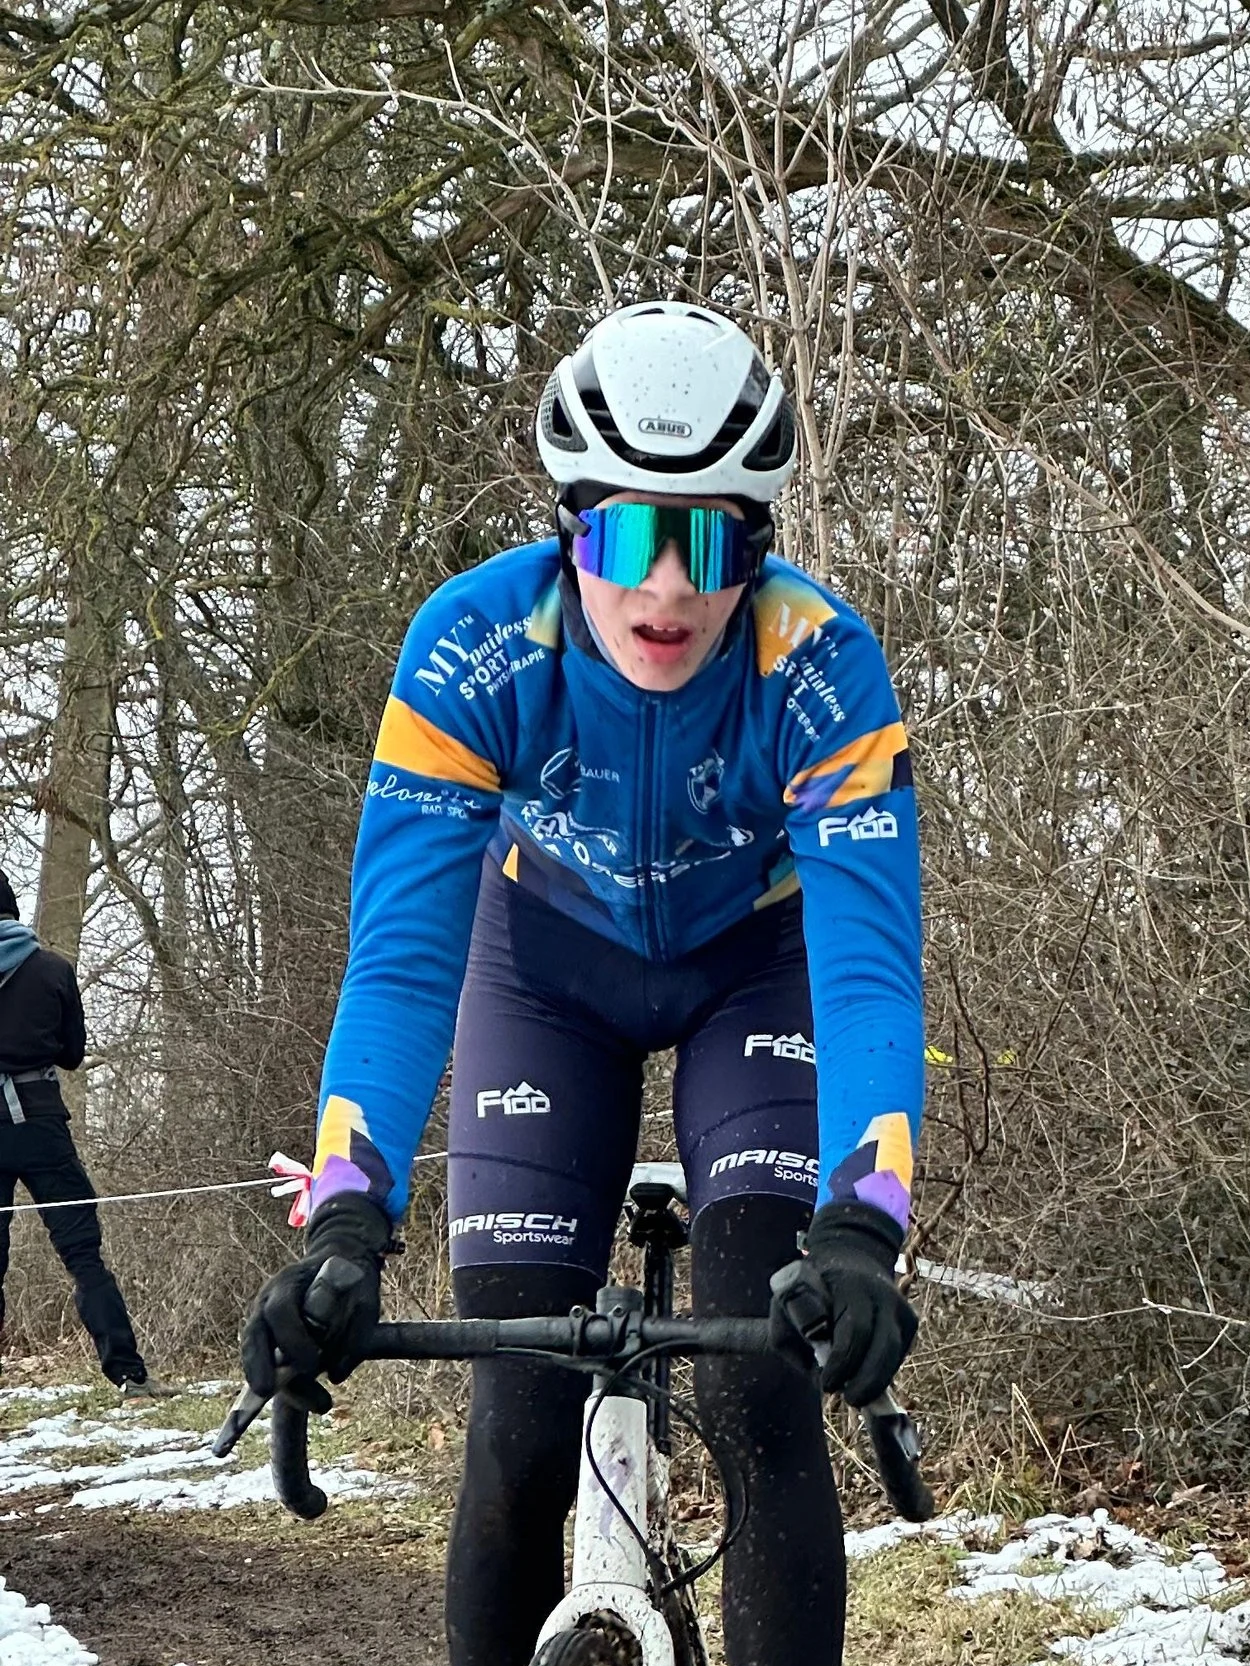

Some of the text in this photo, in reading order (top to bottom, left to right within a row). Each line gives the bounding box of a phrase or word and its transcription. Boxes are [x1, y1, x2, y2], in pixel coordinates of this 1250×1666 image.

[645, 421, 686, 435] ABUS
[709, 1149, 820, 1178] MAISC
[773, 1165, 819, 1188] Sports
[449, 1212, 578, 1240] MAISCH
[493, 1230, 576, 1246] Sportswear
